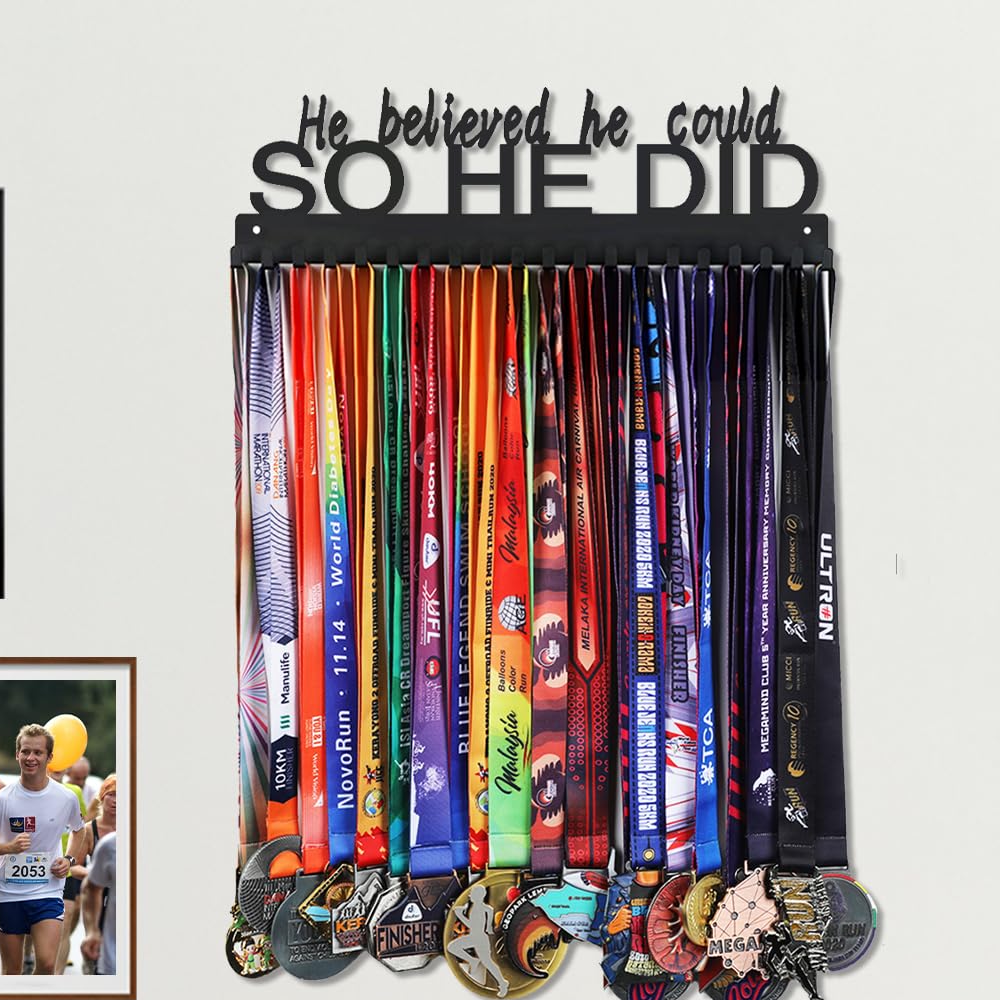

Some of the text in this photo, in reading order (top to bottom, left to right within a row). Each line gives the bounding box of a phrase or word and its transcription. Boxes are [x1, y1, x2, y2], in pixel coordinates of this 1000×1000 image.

[297, 86, 781, 150] He believed he could
[249, 140, 819, 215] SO HE DID
[327, 421, 341, 515] Diabetes
[576, 467, 584, 490] AIR
[498, 481, 520, 563] Malaysia
[577, 493, 588, 594] INTERNATIONAL
[671, 505, 685, 571] KIDNEY
[329, 522, 343, 587] World
[761, 515, 769, 601] ANNIVERSARY
[671, 571, 687, 608] DAY
[427, 599, 441, 644] UFL
[580, 598, 590, 651] MELAKA
[761, 603, 770, 635] YEAR
[332, 620, 348, 676] 11.14
[498, 650, 506, 692] Balloons
[672, 625, 689, 703] FINISHER
[760, 655, 770, 686] CLUB
[785, 655, 793, 682] MICCI
[279, 652, 290, 704] Manulife
[508, 666, 517, 693] Color
[519, 673, 527, 693] Run
[702, 707, 714, 763] TCA
[760, 689, 770, 753] MEGAMIND
[786, 704, 800, 720] 10
[335, 710, 354, 809] NovoRun
[494, 710, 524, 795] Malaysia
[790, 721, 798, 759] REGENCY
[275, 749, 287, 791] 10KM
[785, 787, 805, 809] RUN
[12, 865, 46, 877] 2053
[377, 922, 438, 951] FINISHER
[708, 936, 758, 955] MEGA
